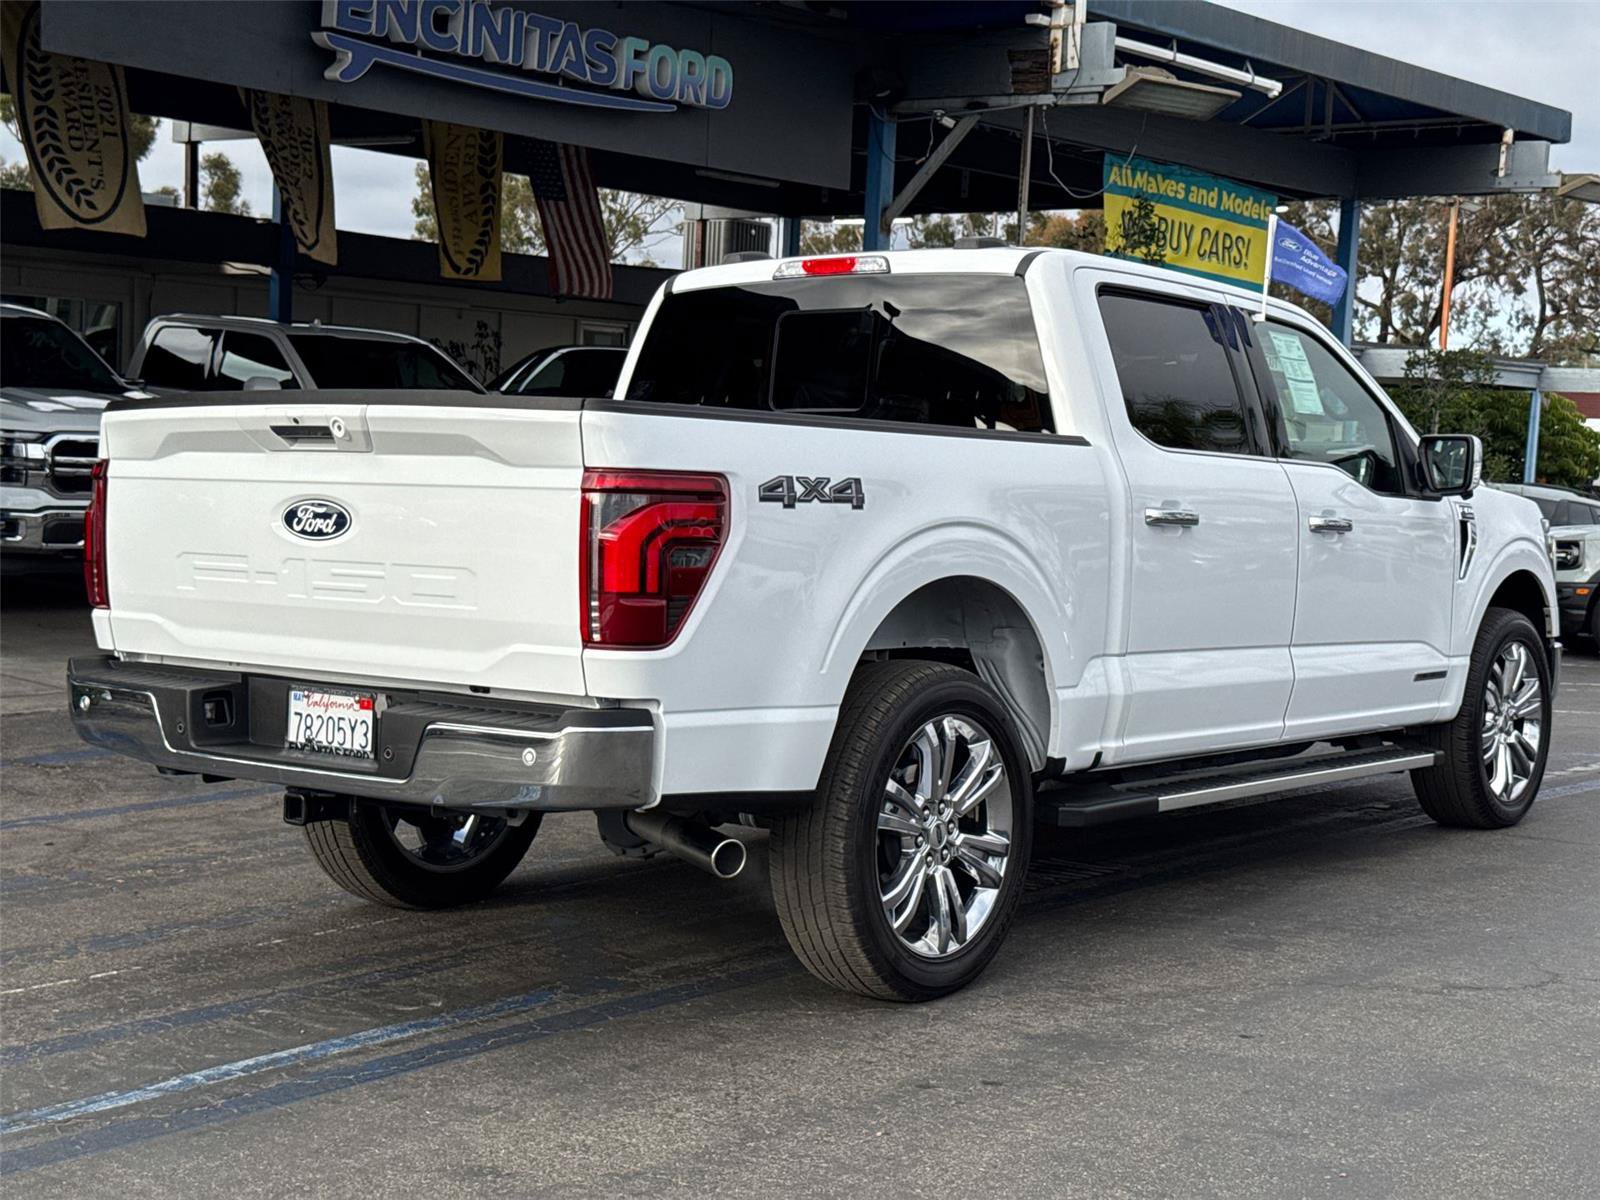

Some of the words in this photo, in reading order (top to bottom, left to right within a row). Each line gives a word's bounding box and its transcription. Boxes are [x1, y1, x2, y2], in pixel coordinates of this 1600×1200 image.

[326, 0, 618, 86] ENCINITAS
[619, 36, 734, 109] FORD
[59, 69, 85, 152] AWARD
[98, 86, 118, 139] 2021
[462, 133, 479, 226] AWARD
[1108, 165, 1132, 188] All
[1132, 170, 1186, 200] Makes
[1188, 186, 1218, 209] and
[1221, 190, 1272, 222] Models
[1156, 215, 1194, 258] BUY
[1197, 226, 1252, 271] CARS!
[293, 504, 337, 534] Ford
[305, 691, 359, 713] California
[294, 711, 370, 750] 78205Y3
